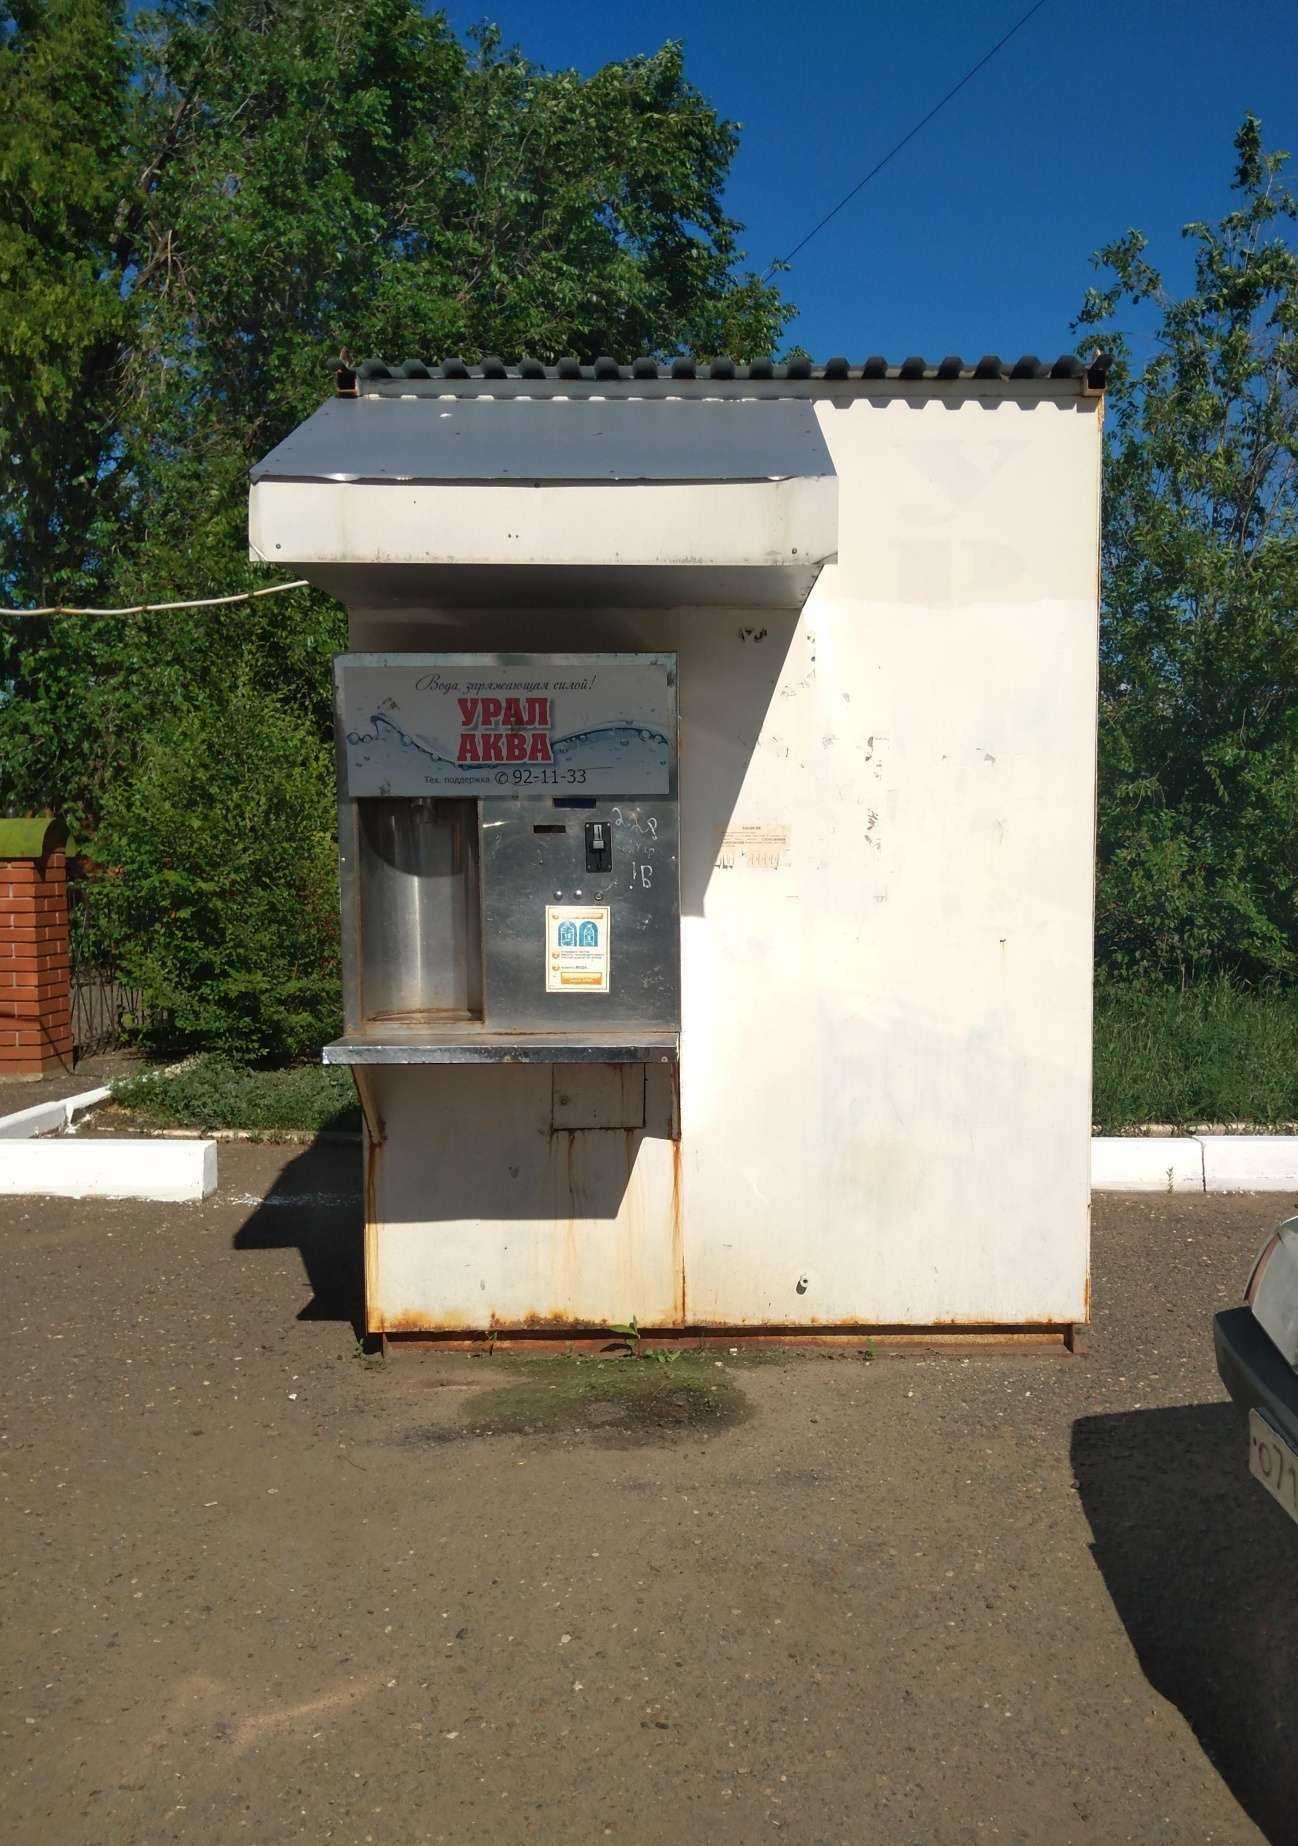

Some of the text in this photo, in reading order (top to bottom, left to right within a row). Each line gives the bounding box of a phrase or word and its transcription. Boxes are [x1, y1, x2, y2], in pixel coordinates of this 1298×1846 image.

[552, 673, 597, 690] силой!
[457, 697, 549, 727] УРАЛ
[456, 733, 552, 762] АКВА
[444, 775, 490, 785] поддержка
[512, 769, 587, 785] 92-11-33
